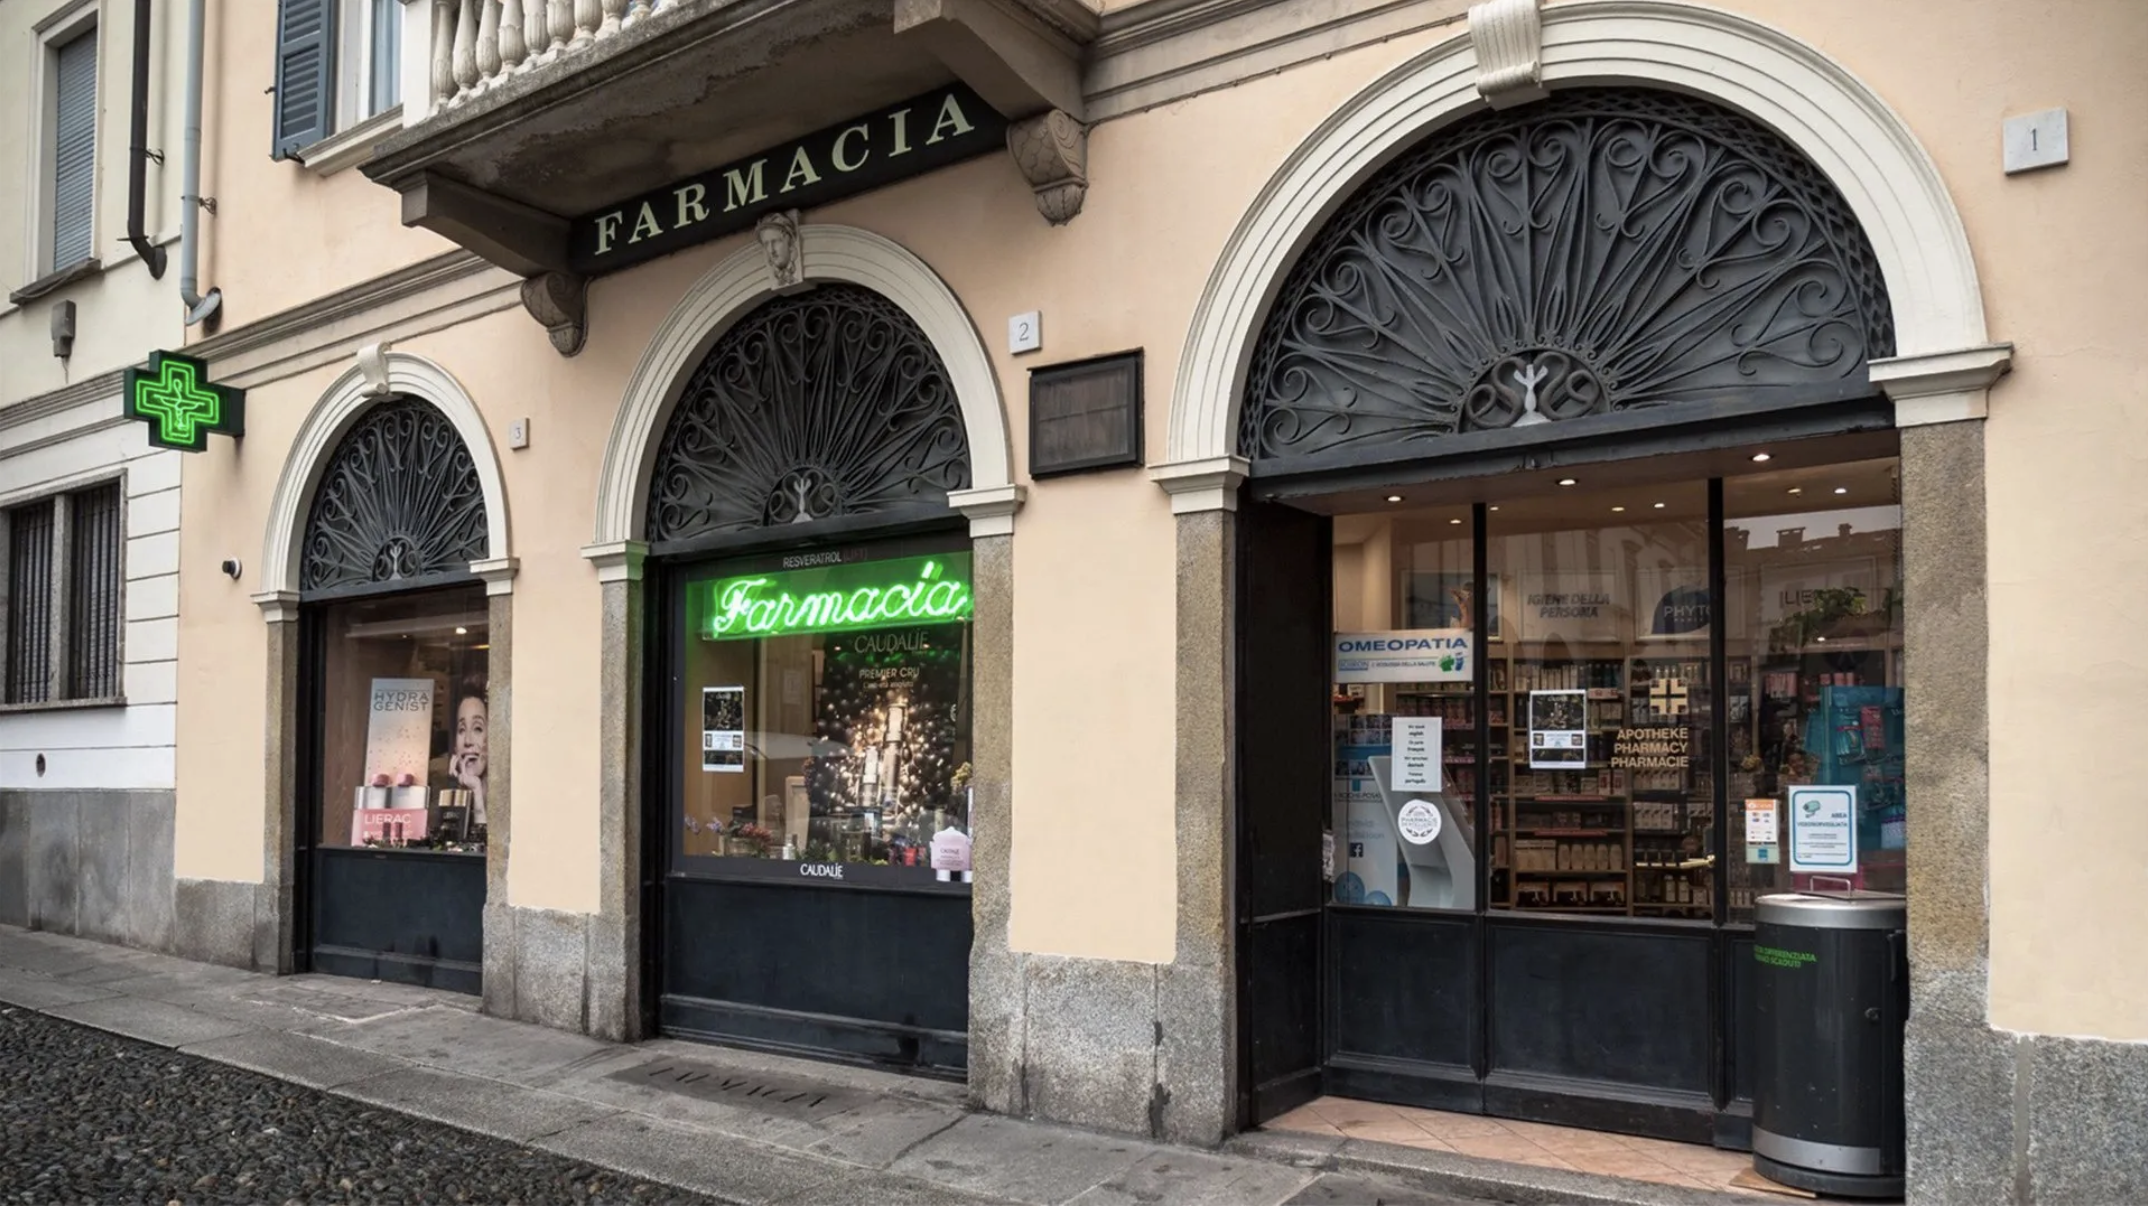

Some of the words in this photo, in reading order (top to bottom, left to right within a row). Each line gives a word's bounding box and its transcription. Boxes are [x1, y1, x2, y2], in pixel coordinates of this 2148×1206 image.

[2031, 127, 2037, 151] 1
[594, 93, 975, 256] FARMACIA
[1019, 322, 1029, 341] 2
[783, 551, 842, 568] RESVERATROL
[714, 560, 968, 632] Farmacia
[1528, 594, 1567, 606] IGIENE
[1571, 593, 1610, 605] DELLA
[1540, 606, 1599, 618] PERSONA
[1338, 638, 1468, 652] OMEOPATIA
[858, 668, 897, 678] PREMIER
[900, 666, 920, 678] CRU
[374, 691, 429, 701] HYDRA
[373, 701, 428, 711] GENIST
[1617, 728, 1688, 739] APOTHEKE
[1614, 742, 1688, 753] PHARMACY
[1611, 756, 1688, 767] PHARMACIE
[365, 813, 412, 825] LIERAC
